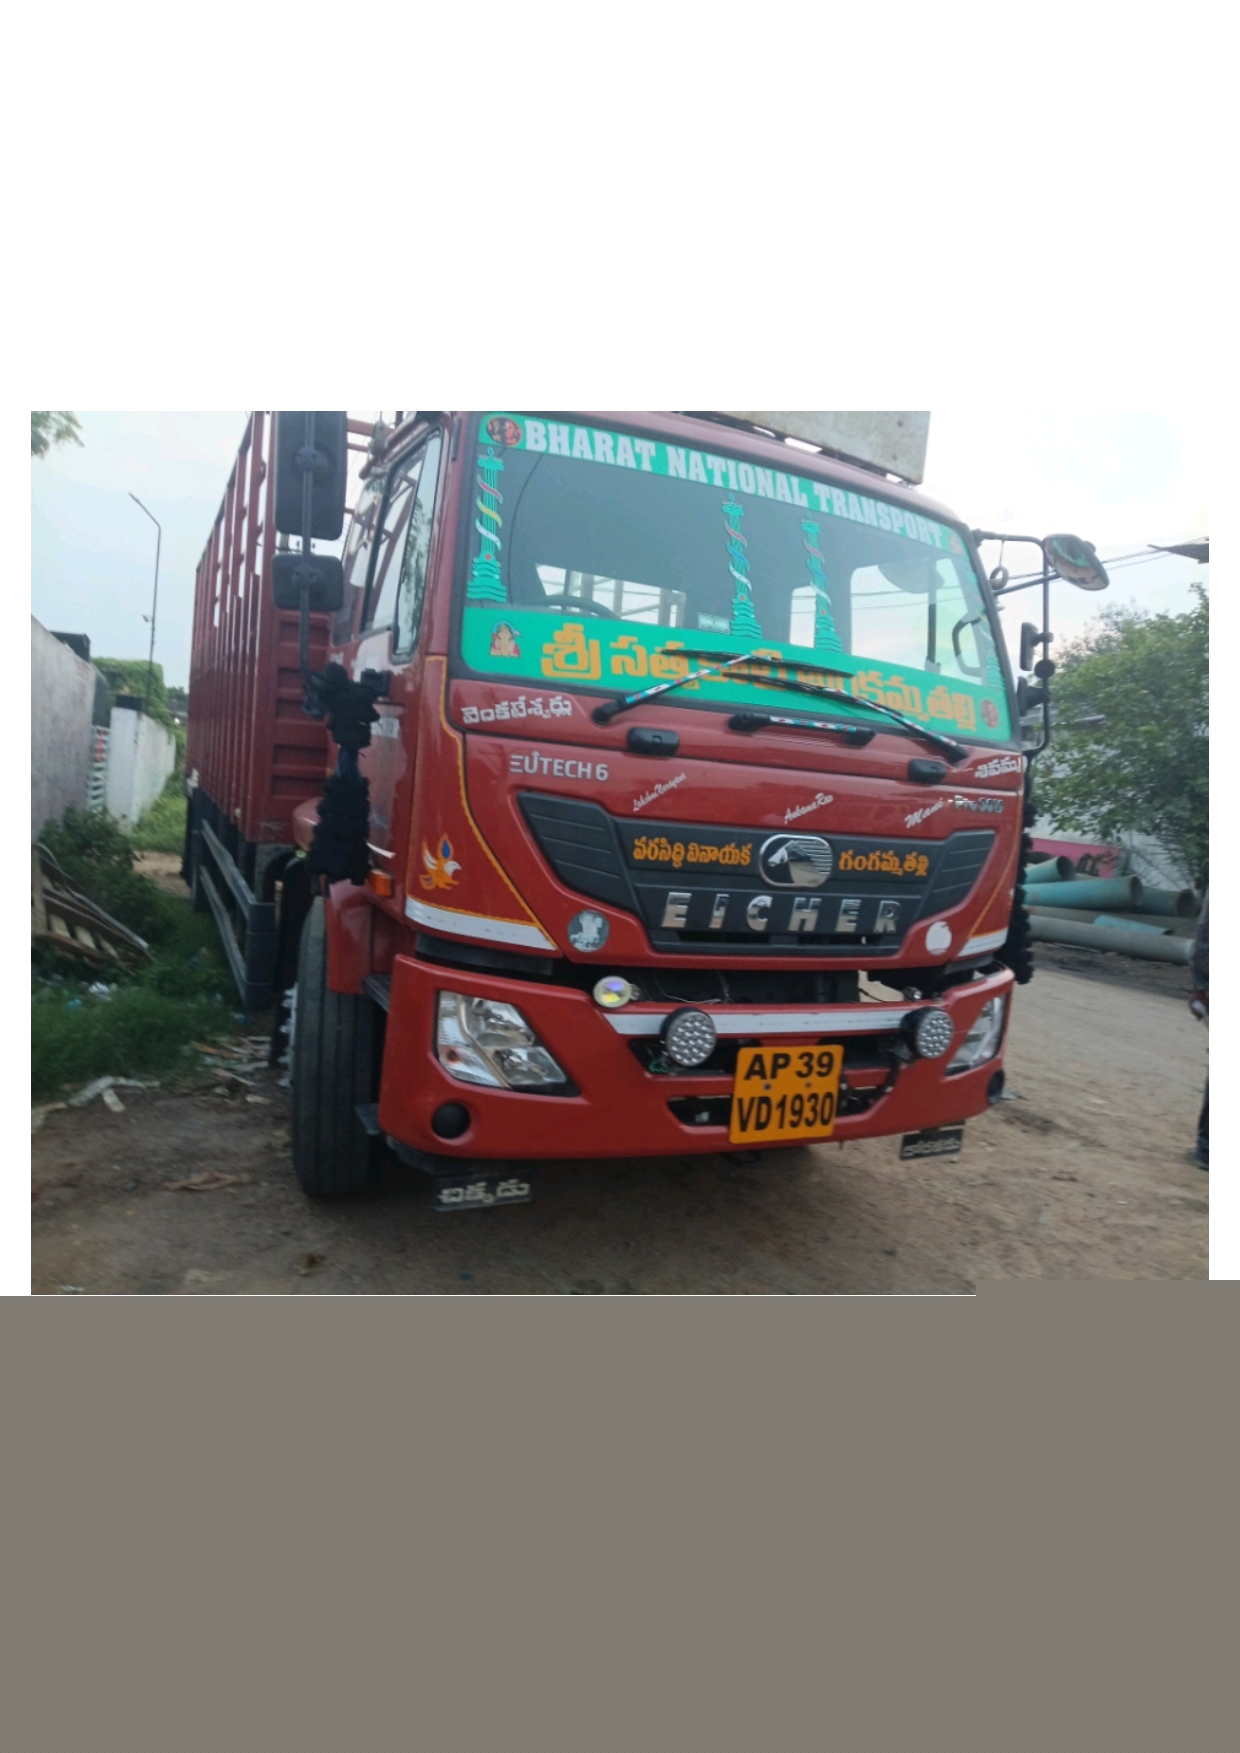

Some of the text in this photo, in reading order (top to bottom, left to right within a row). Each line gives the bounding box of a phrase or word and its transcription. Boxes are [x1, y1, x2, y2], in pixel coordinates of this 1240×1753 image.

[524, 419, 943, 549] BHARAT NATIONAL TRANSPORT
[541, 622, 602, 680] శ్రీ
[510, 751, 609, 781] EUTECH 6
[660, 891, 900, 933] EICHER
[743, 1051, 835, 1081] AP 39
